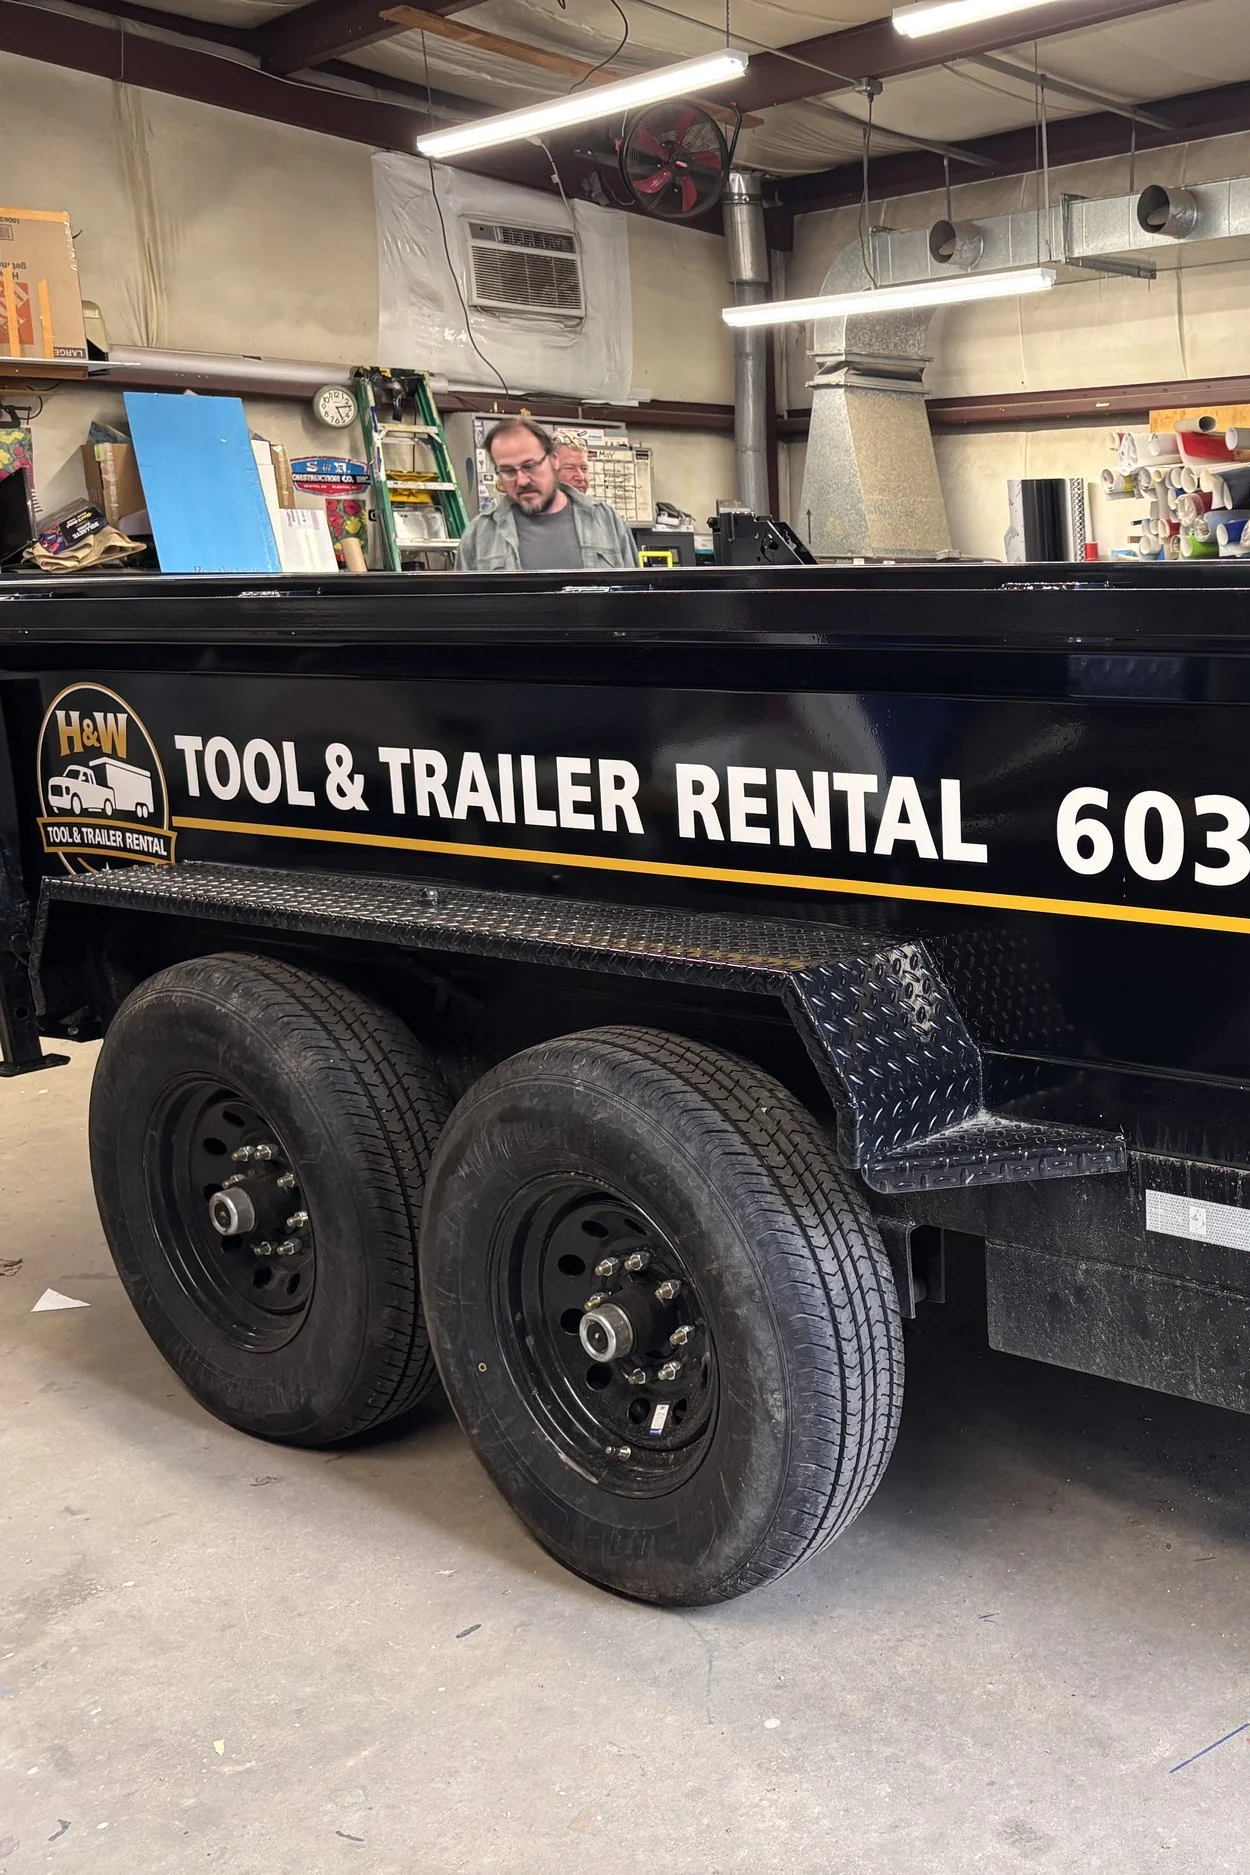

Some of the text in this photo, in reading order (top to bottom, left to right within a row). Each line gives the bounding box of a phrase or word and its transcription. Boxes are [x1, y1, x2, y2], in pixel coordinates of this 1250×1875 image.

[53, 348, 83, 358] LARGE
[55, 710, 128, 759] H&W
[174, 735, 988, 864] TOOL & TRAILER RENTAL
[46, 826, 168, 856] TOOL & TRAILER RENTAL
